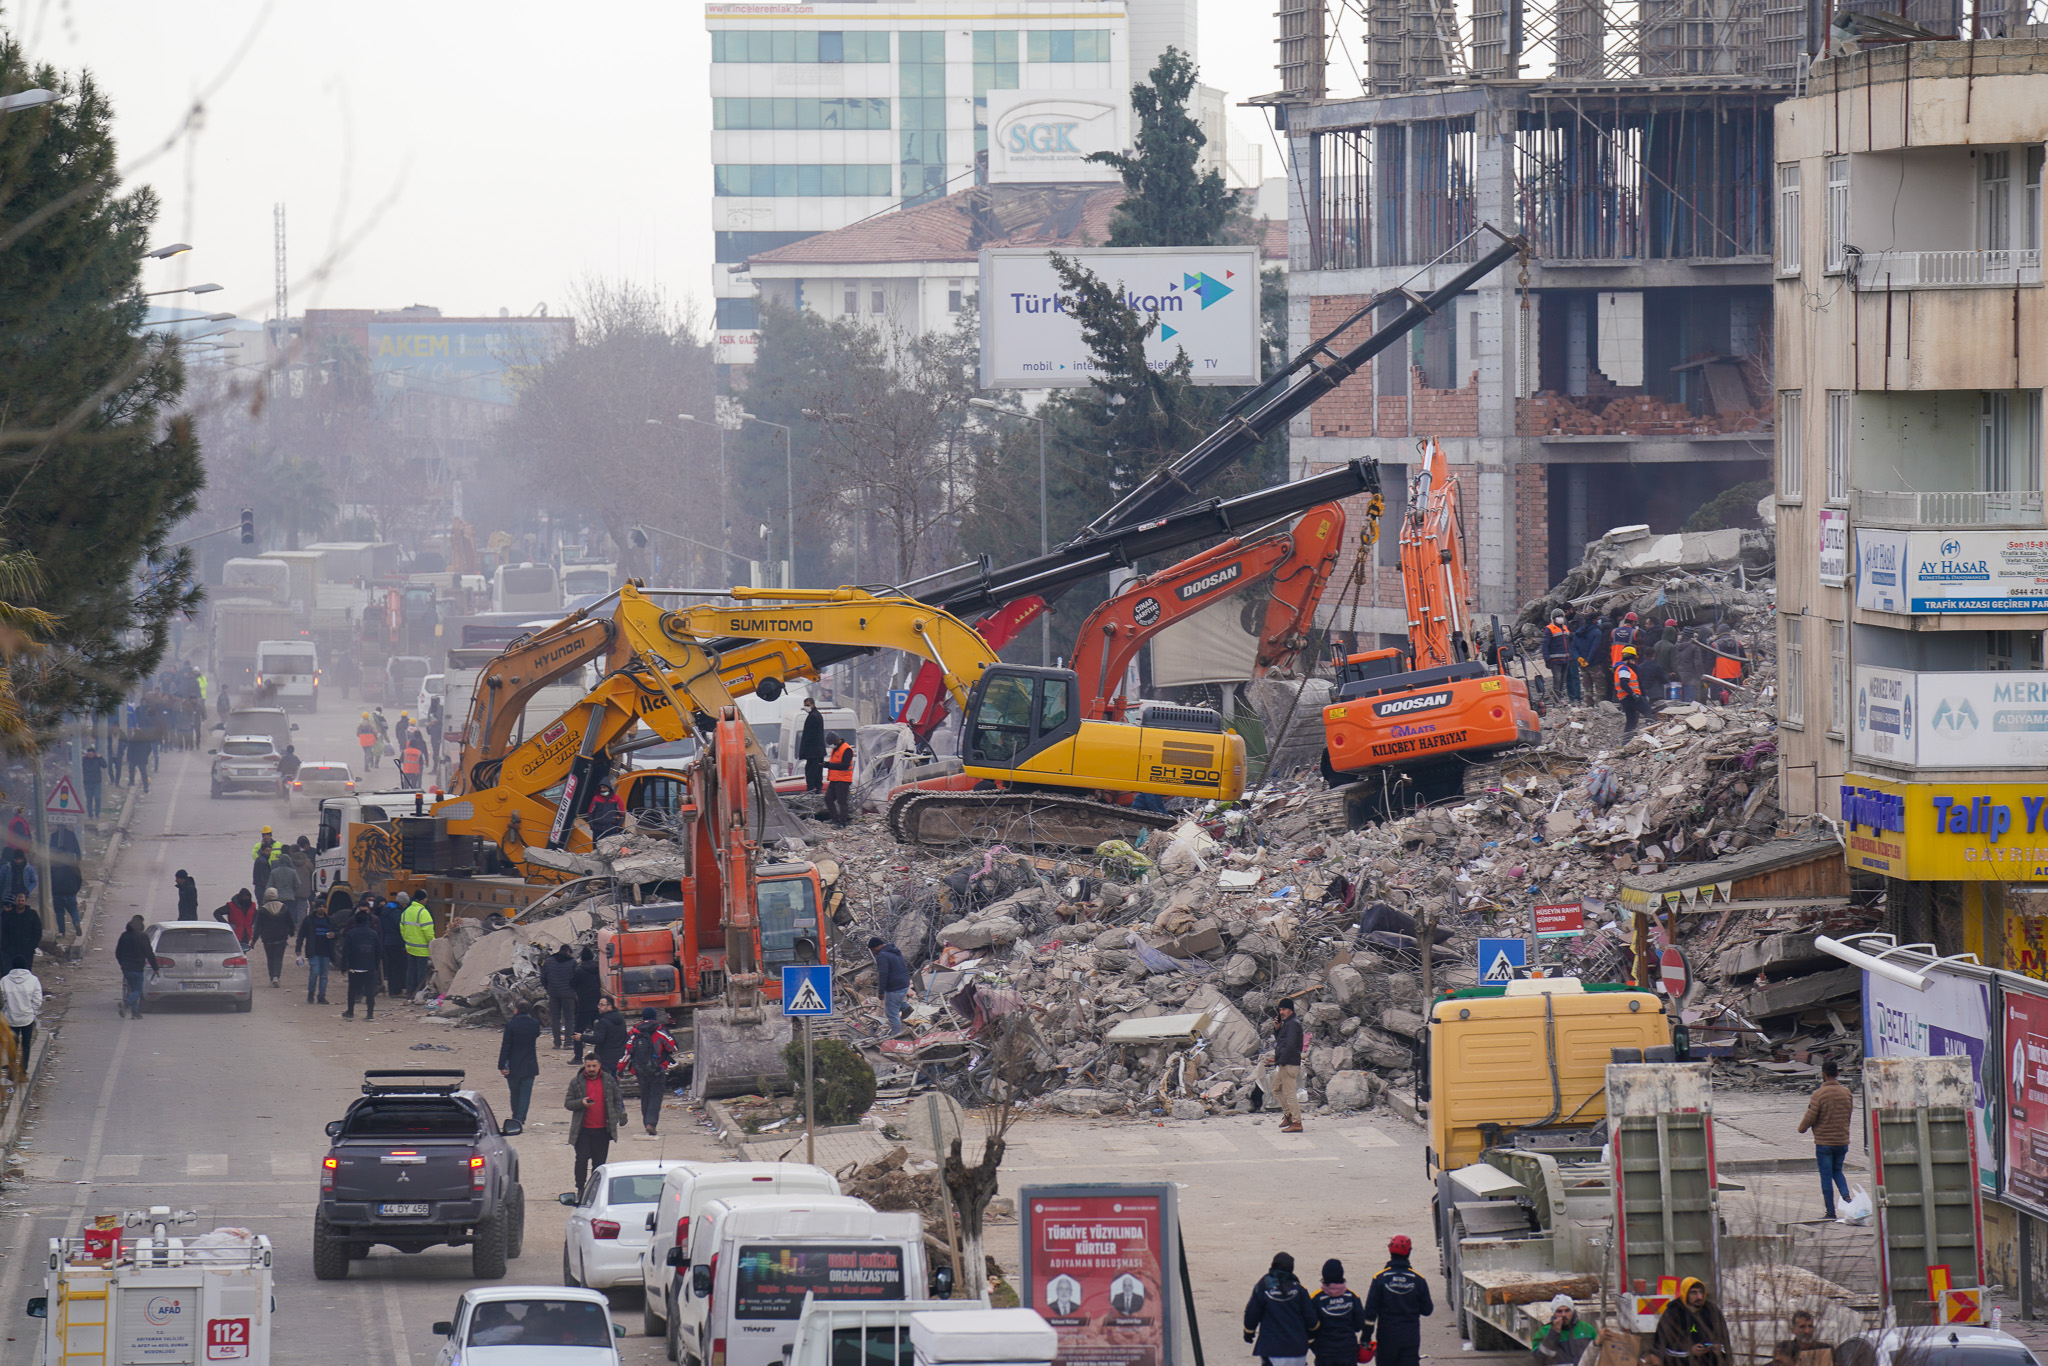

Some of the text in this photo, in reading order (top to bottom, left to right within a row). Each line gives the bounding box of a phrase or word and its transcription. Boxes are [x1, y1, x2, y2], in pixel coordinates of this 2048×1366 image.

[1009, 123, 1081, 153] SGK
[1010, 291, 1067, 314] Türk
[378, 335, 449, 357] AKEM
[1022, 360, 1053, 371] mobil
[1204, 359, 1218, 369] TV
[1182, 565, 1237, 598] DOOSAN
[1925, 599, 1957, 609] TRAFİK
[1958, 600, 1990, 609] KAZASI
[1991, 598, 2030, 609] GEÇİREN
[730, 619, 813, 632] SUMITOMO
[534, 638, 586, 669] HYUNDAI
[894, 692, 908, 713] P
[1380, 694, 1448, 715] DOOSAN
[1372, 739, 1416, 757] KILIÇBEY
[1150, 766, 1220, 782] SH 300
[1932, 796, 2011, 843] Talip
[1536, 906, 1580, 916] HÜSEYİN RAHMİ
[1537, 915, 1566, 923] GÜRPINAR
[383, 1204, 428, 1213] 44 DY 456
[1047, 1224, 1144, 1240] TÜRKİYE YÜZYILINDA
[1075, 1239, 1117, 1255] KÜRTLER
[858, 1252, 898, 1268] MÜZİK
[1049, 1258, 1143, 1269] ADIYAMAN BULUŞMASI
[829, 1268, 899, 1283] ORGANİZASYON
[158, 1306, 181, 1314] AFAD
[213, 1323, 244, 1343] 112
